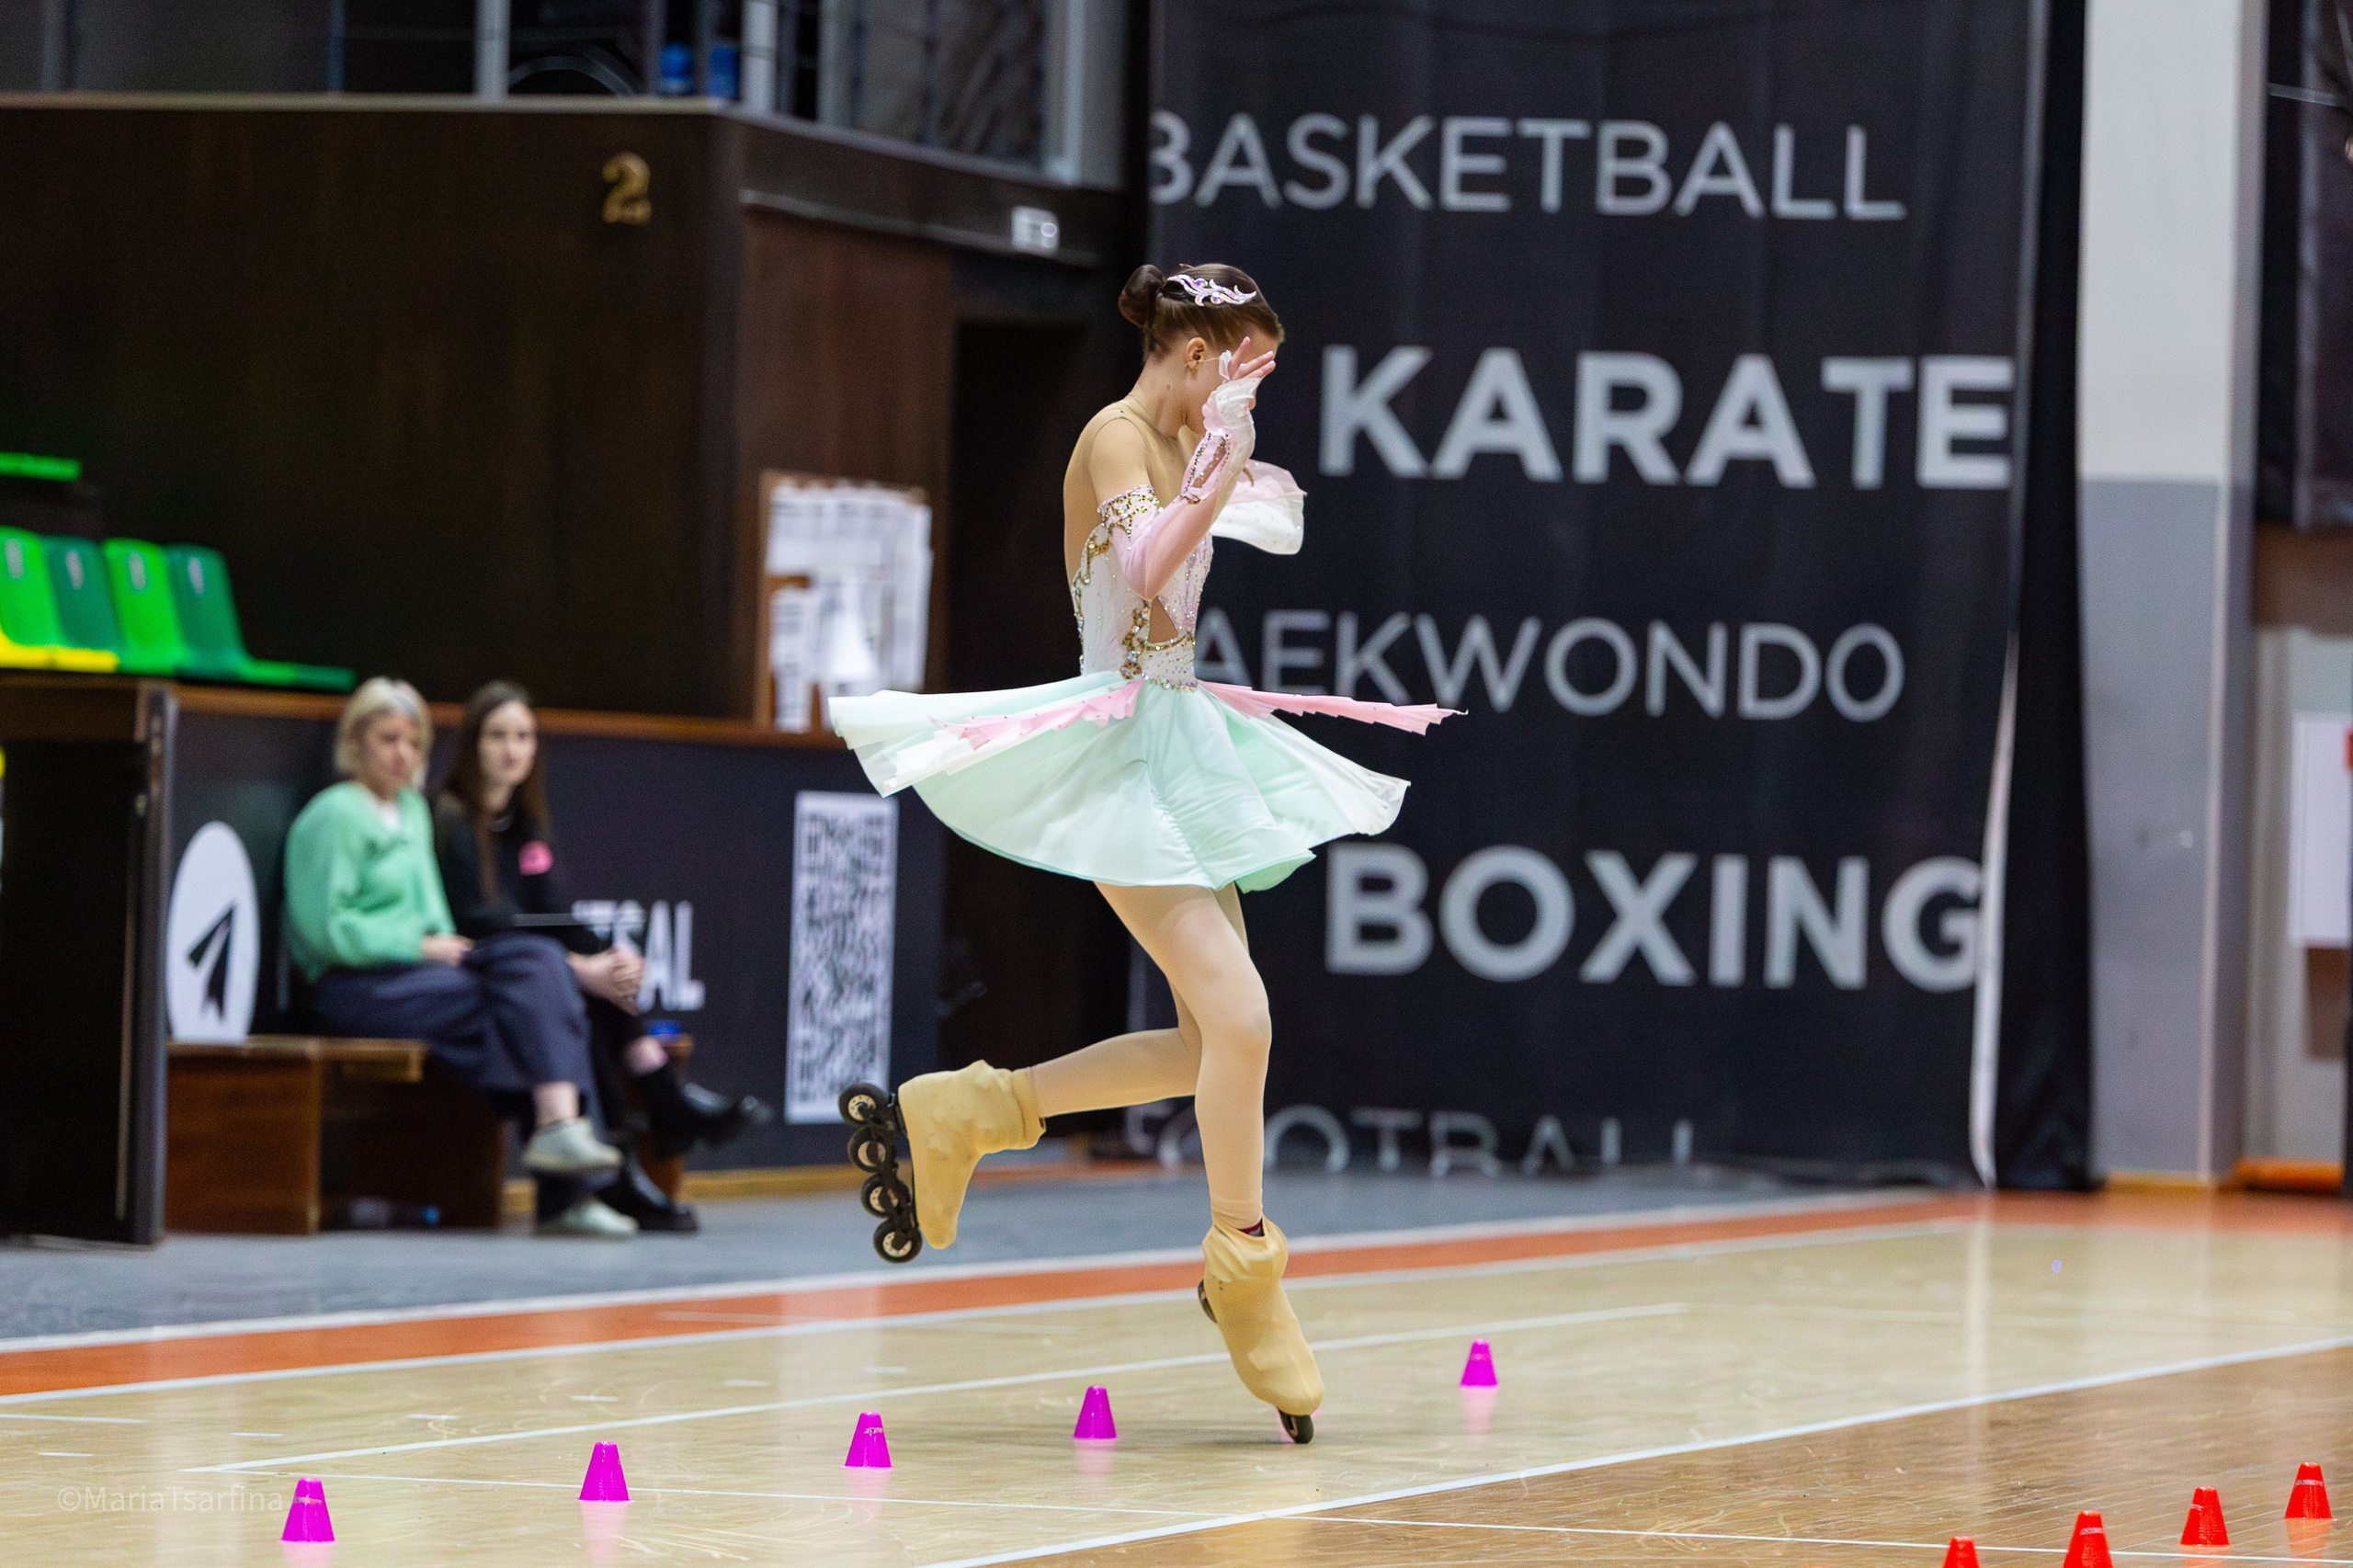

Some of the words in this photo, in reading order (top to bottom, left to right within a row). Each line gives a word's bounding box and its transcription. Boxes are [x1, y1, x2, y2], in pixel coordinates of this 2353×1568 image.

[602, 152, 652, 225] 2
[1150, 110, 1907, 221] BASKETBALL
[1318, 344, 2015, 490] KARATE
[1324, 841, 1984, 994] BOXING
